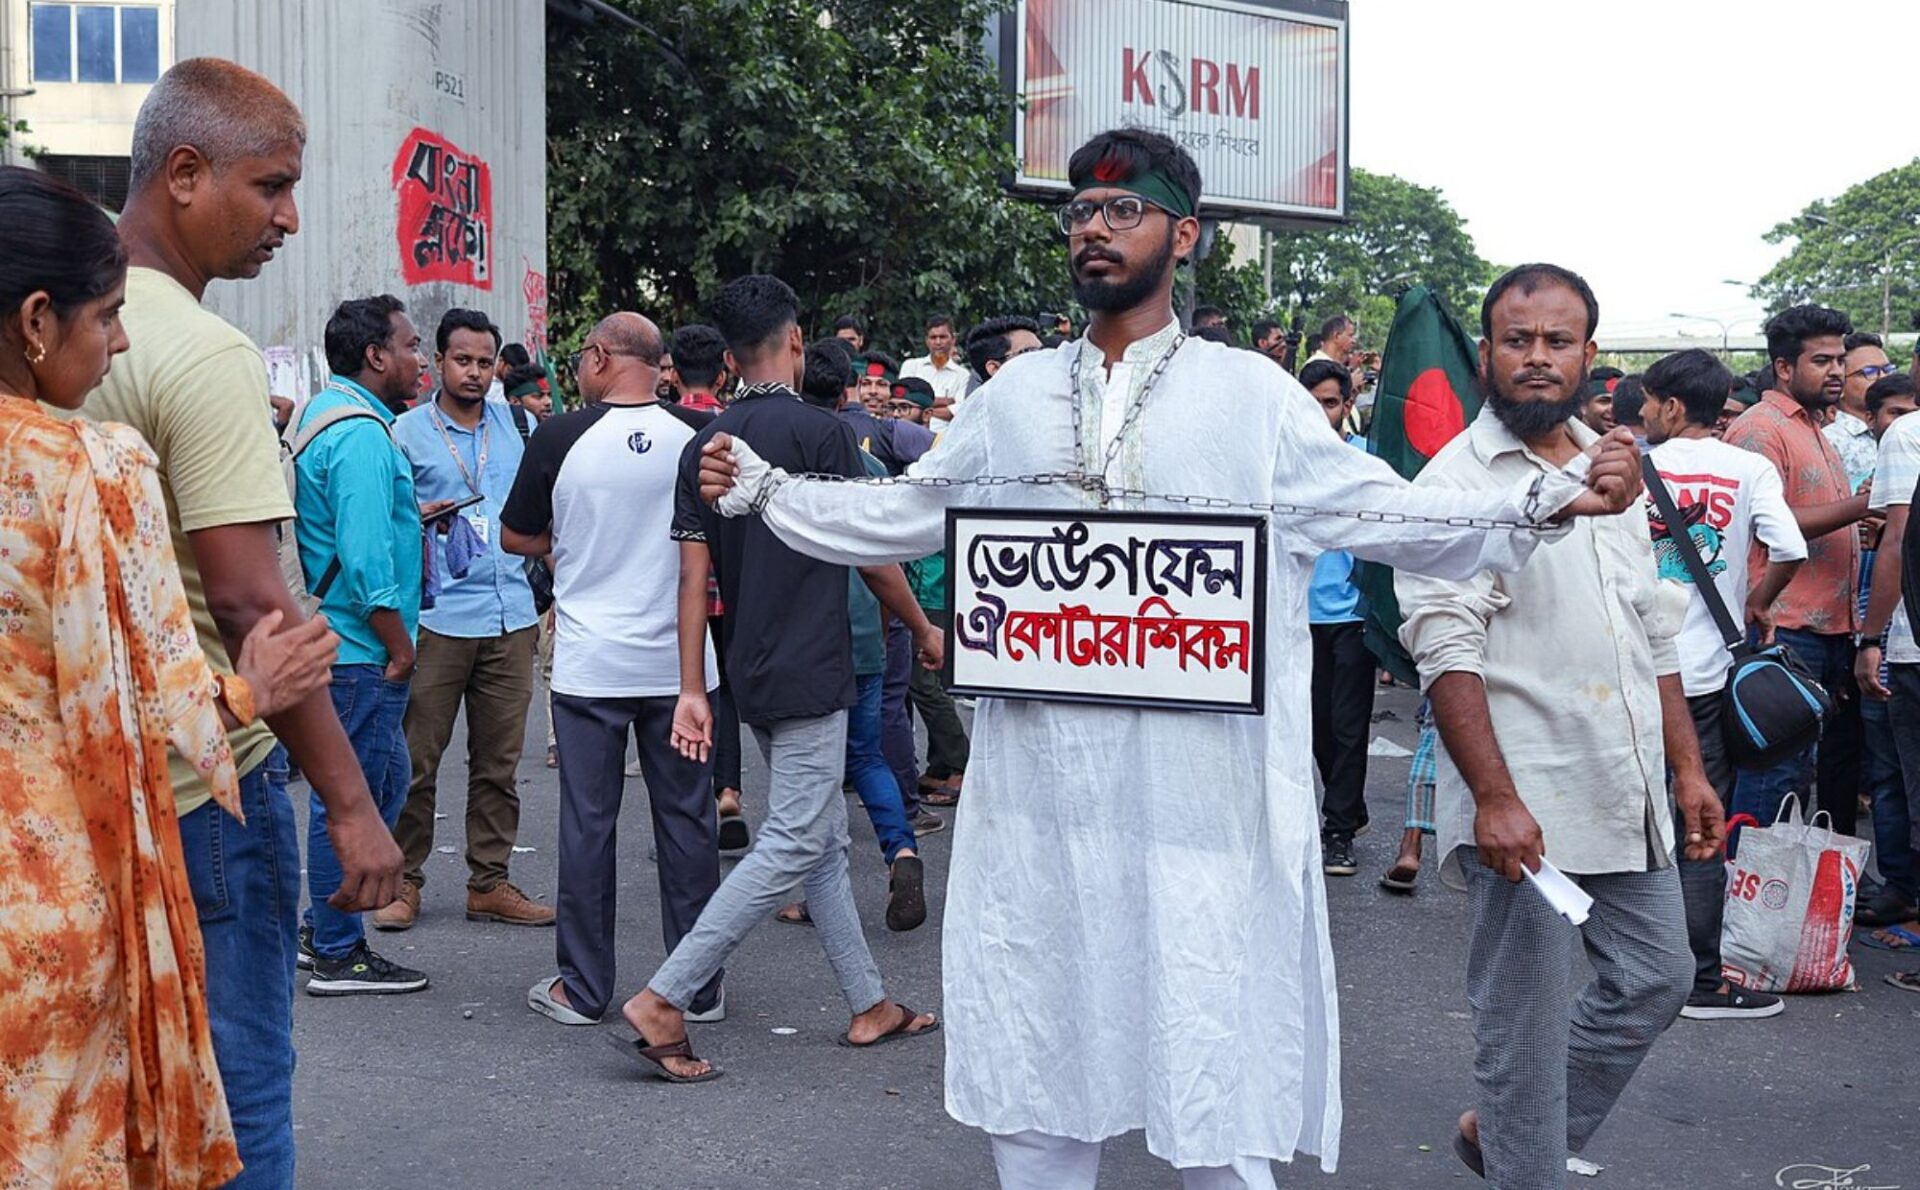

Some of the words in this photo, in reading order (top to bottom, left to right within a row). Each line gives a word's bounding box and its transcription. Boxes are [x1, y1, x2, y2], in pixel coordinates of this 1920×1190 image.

[435, 71, 464, 98] P521
[1122, 47, 1260, 120] KSRM
[1214, 128, 1259, 156] শিখরে
[956, 591, 1007, 660] ঐ
[1004, 603, 1132, 668] কোটার
[1132, 596, 1251, 675] শিকল
